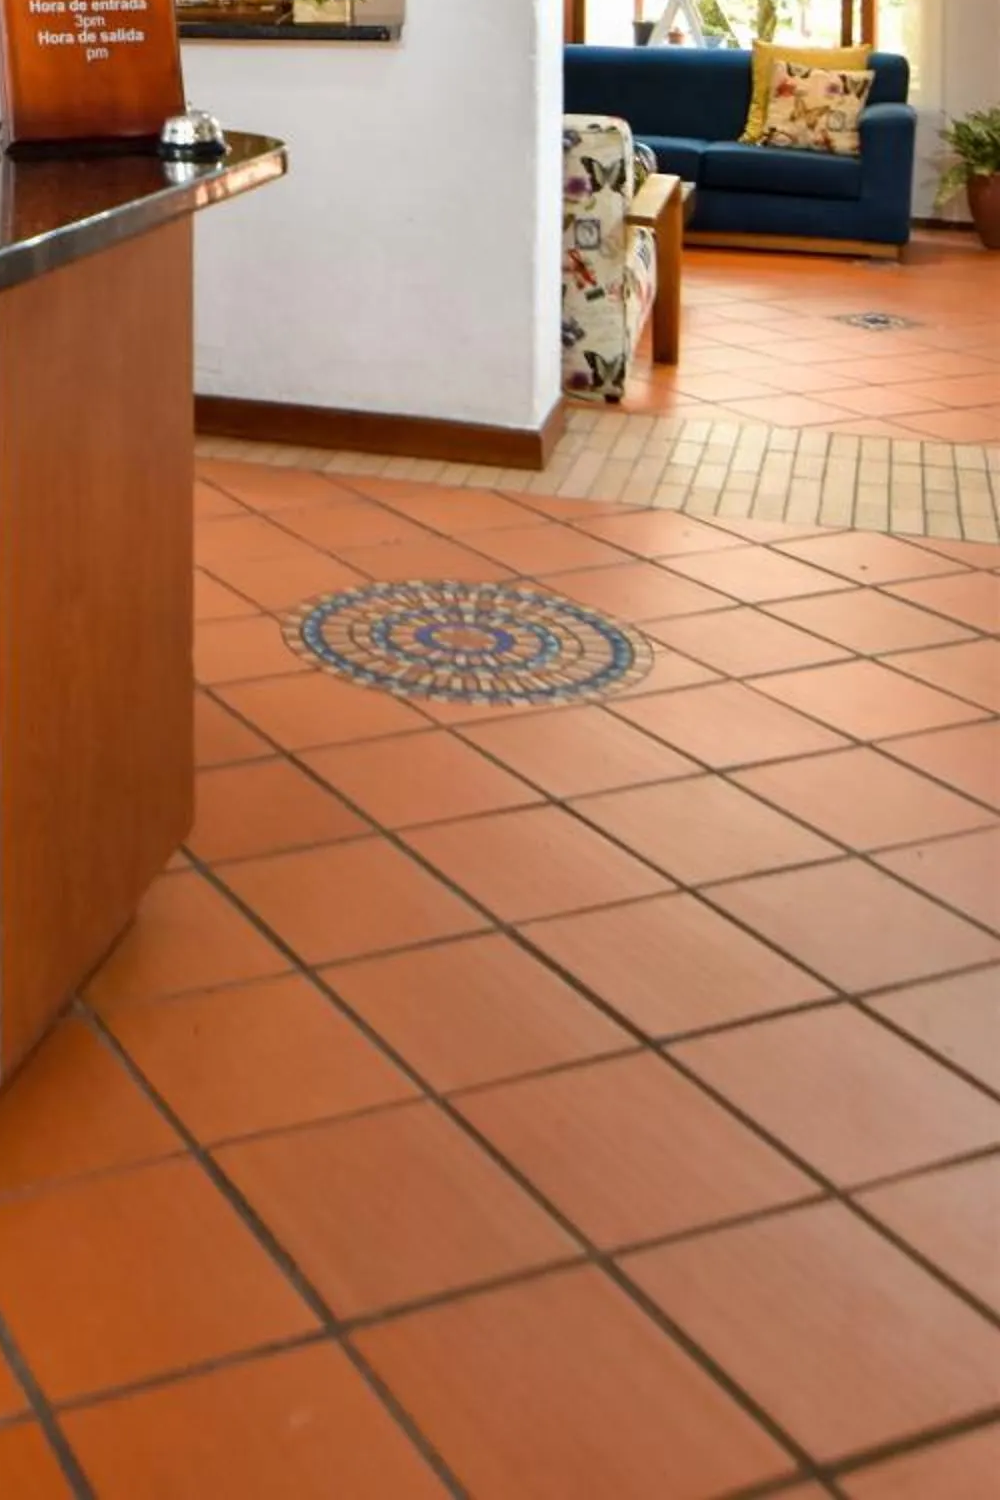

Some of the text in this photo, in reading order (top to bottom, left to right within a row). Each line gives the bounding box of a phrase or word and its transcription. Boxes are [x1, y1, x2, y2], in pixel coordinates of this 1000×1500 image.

[74, 14, 105, 29] 3pm
[38, 28, 144, 44] Hora de salida
[86, 47, 109, 62] pm
